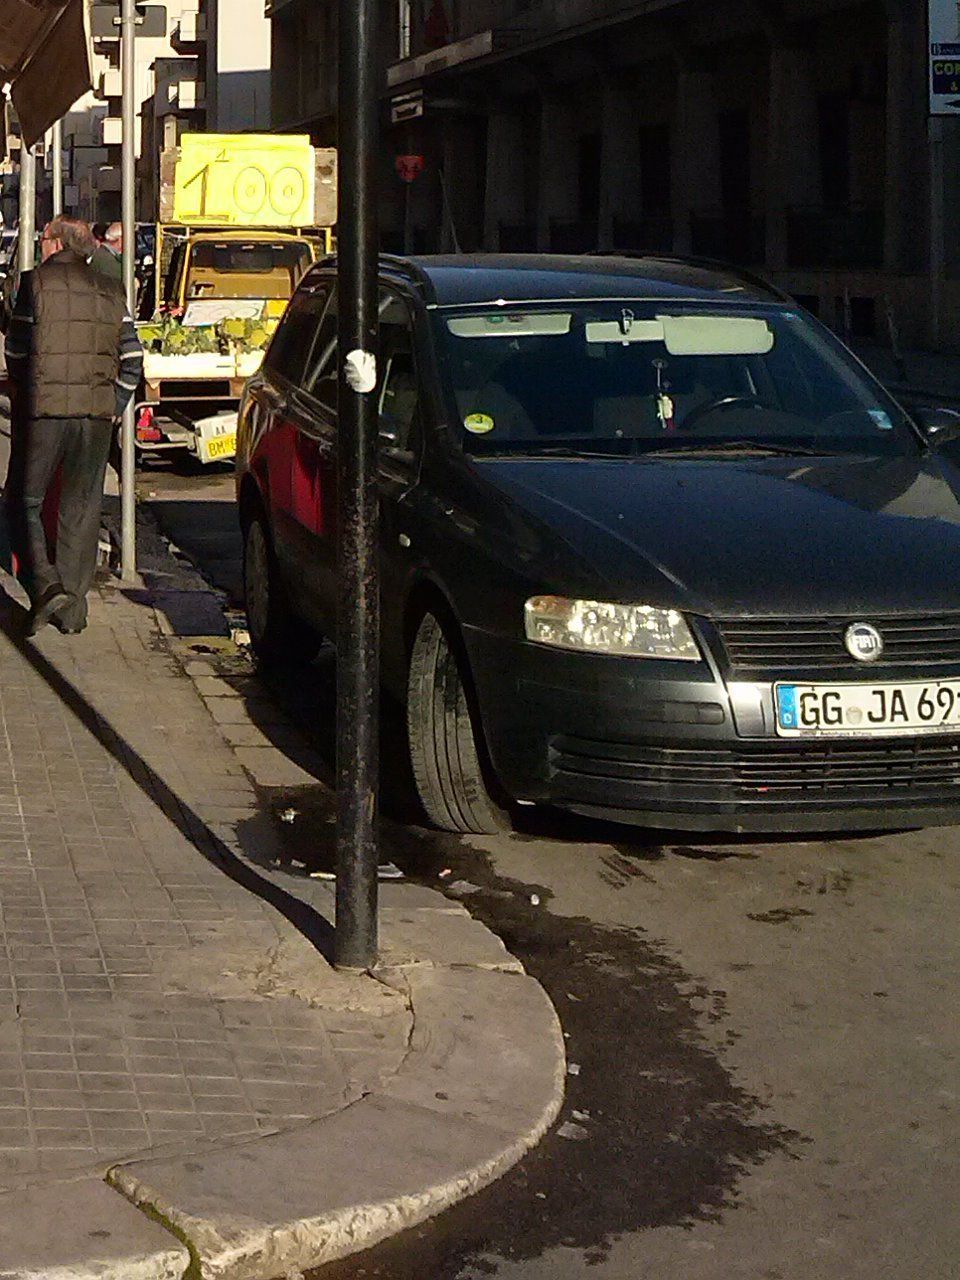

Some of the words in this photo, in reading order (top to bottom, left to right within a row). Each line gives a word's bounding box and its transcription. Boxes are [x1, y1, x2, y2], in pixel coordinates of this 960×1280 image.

[799, 691, 843, 726] GG
[867, 688, 909, 723] JA
[916, 686, 960, 722] 69
